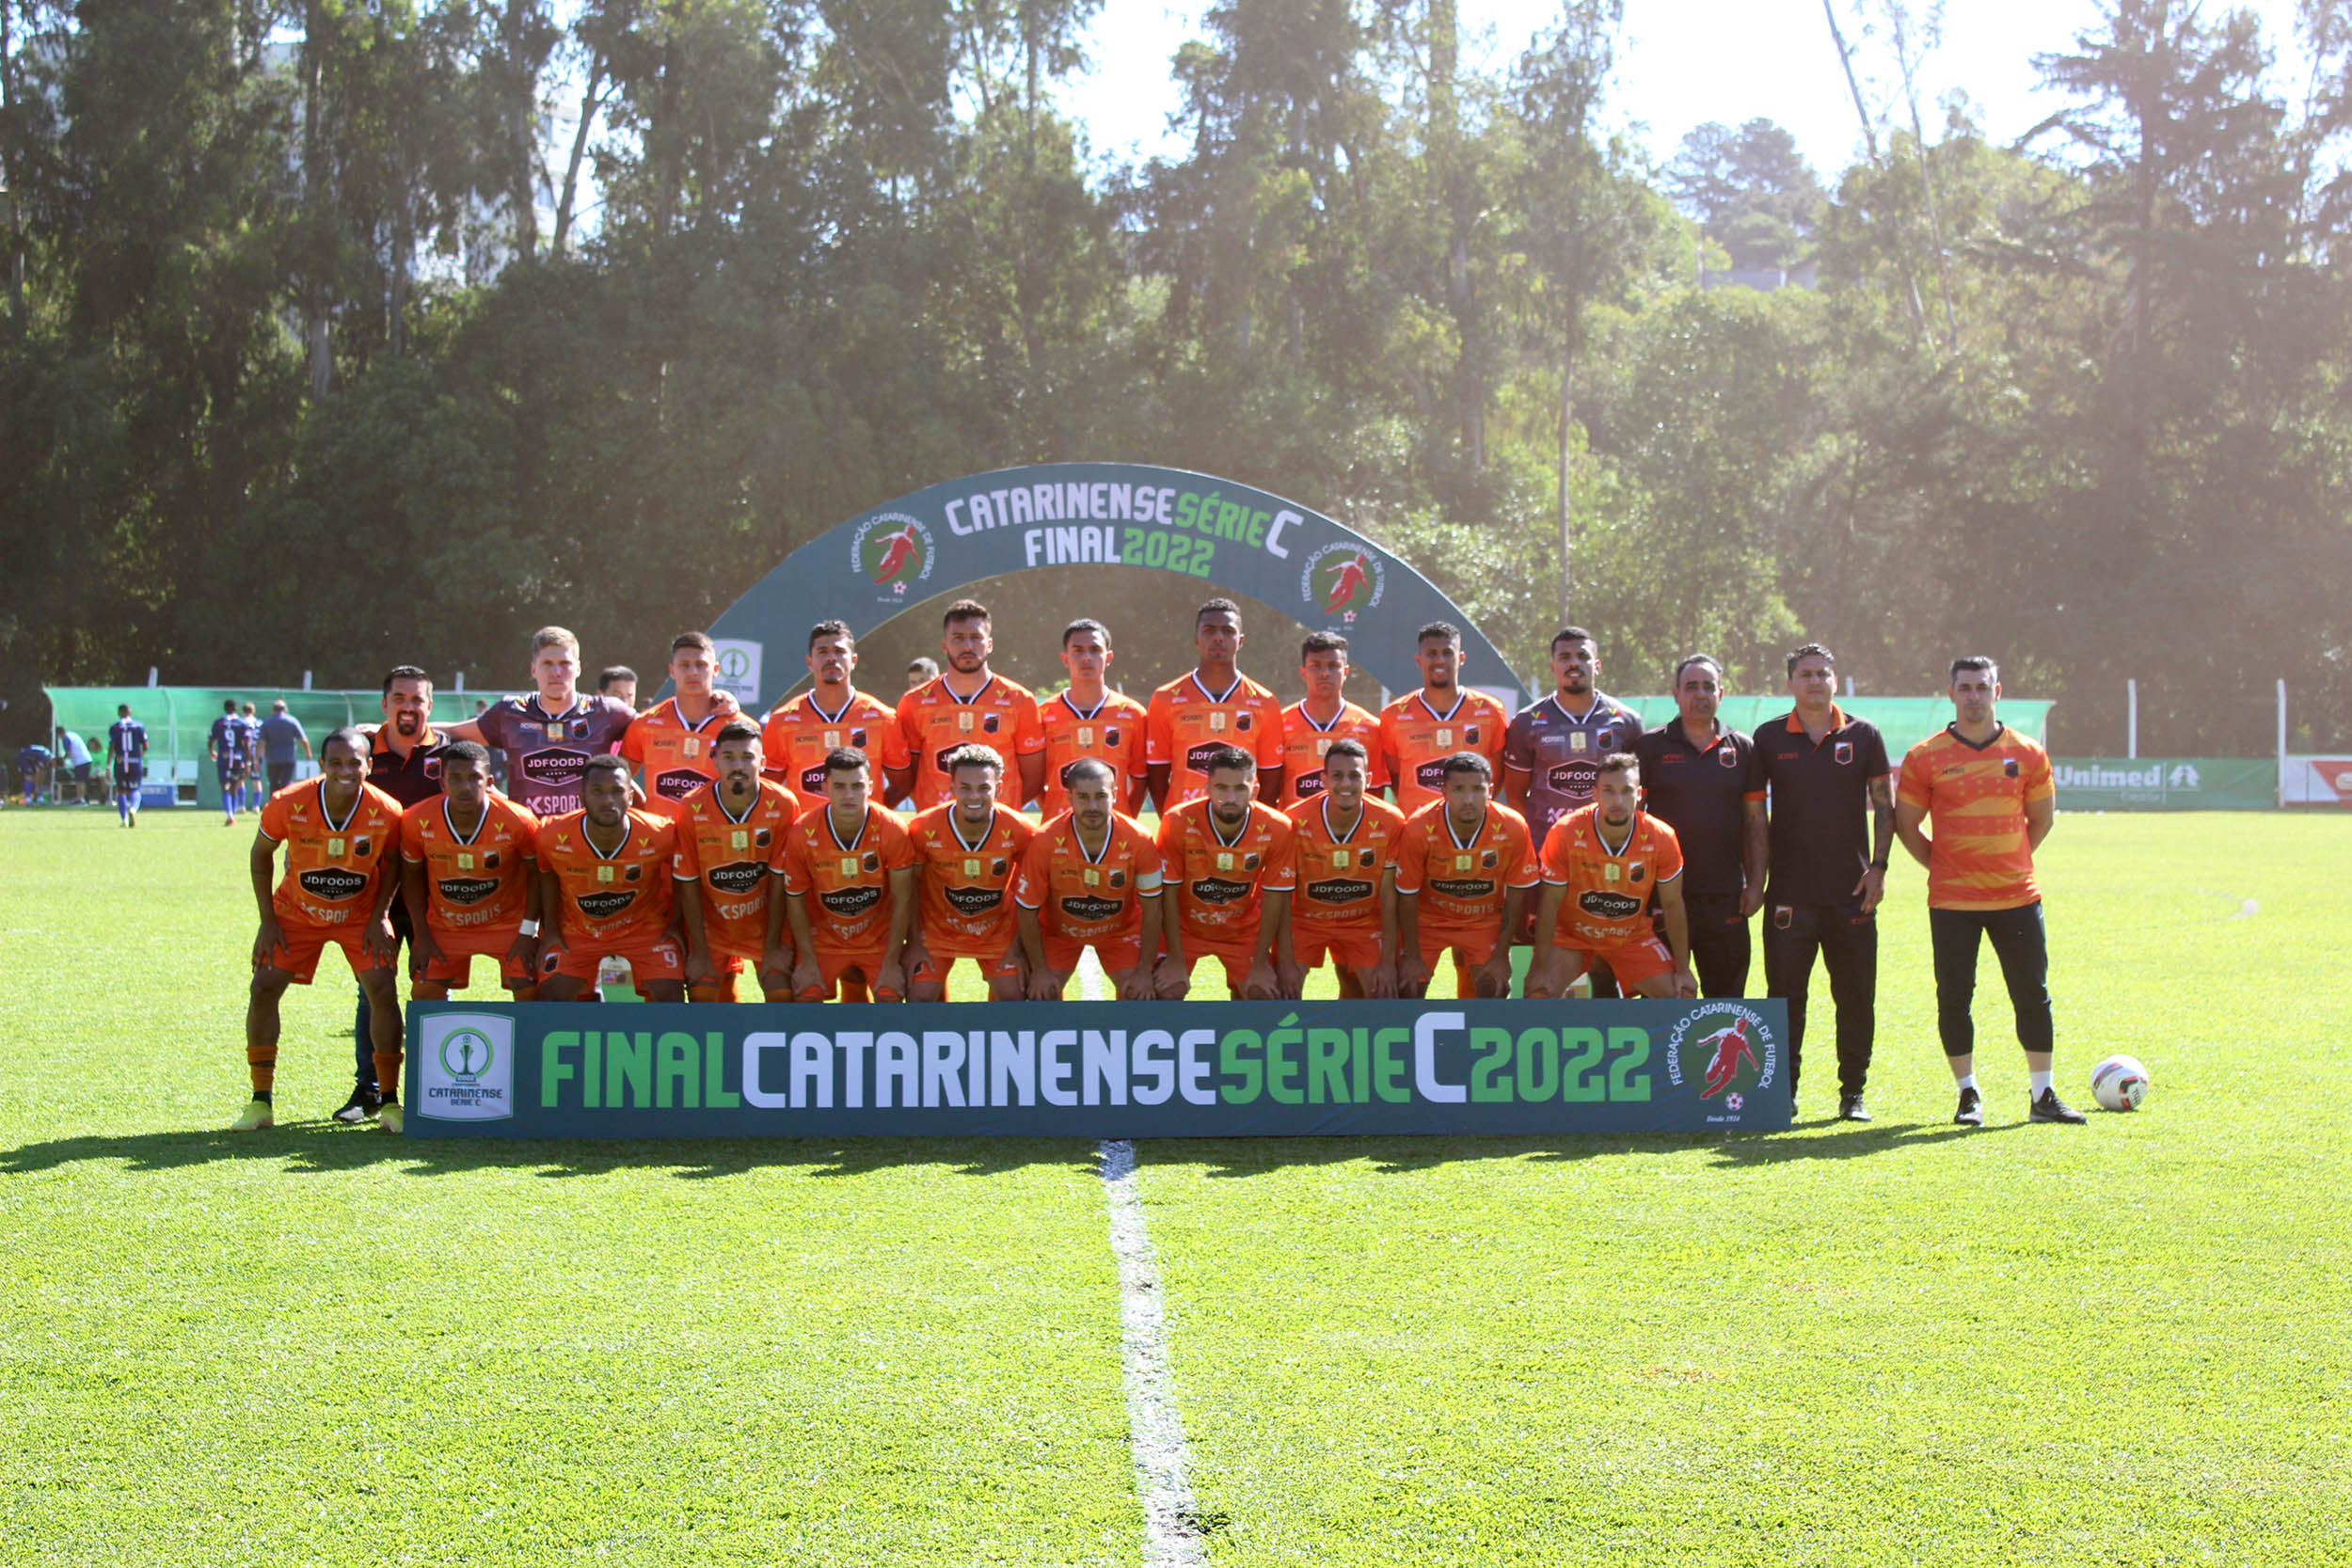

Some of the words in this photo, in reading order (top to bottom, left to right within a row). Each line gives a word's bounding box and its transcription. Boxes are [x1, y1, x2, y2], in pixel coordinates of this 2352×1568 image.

[945, 483, 1176, 536] CATARINENSE
[1174, 491, 1272, 548] SÉRIE
[1265, 509, 1305, 560] C
[1025, 526, 1120, 567] FINAL
[1120, 527, 1216, 578] 2022
[121, 732, 133, 752] 11
[225, 729, 235, 748] 9
[527, 757, 584, 768] JDFOODS
[2052, 765, 2161, 787] Unimed
[304, 875, 362, 886] JDFOODS
[663, 950, 677, 968] 9
[1690, 1002, 1763, 1027] CATARINENSE
[1756, 1024, 1773, 1042] DE
[541, 1031, 740, 1108] FINAL
[741, 1029, 1216, 1108] CATARINENSE
[1219, 1012, 1411, 1105] SÉRIE
[1414, 1012, 1467, 1103] C
[1469, 1027, 1651, 1103] 2022
[1666, 1017, 1692, 1086] FEDERAÇÃO
[1757, 1043, 1776, 1089] FUTEBOL
[428, 1087, 503, 1099] CATARINENSE
